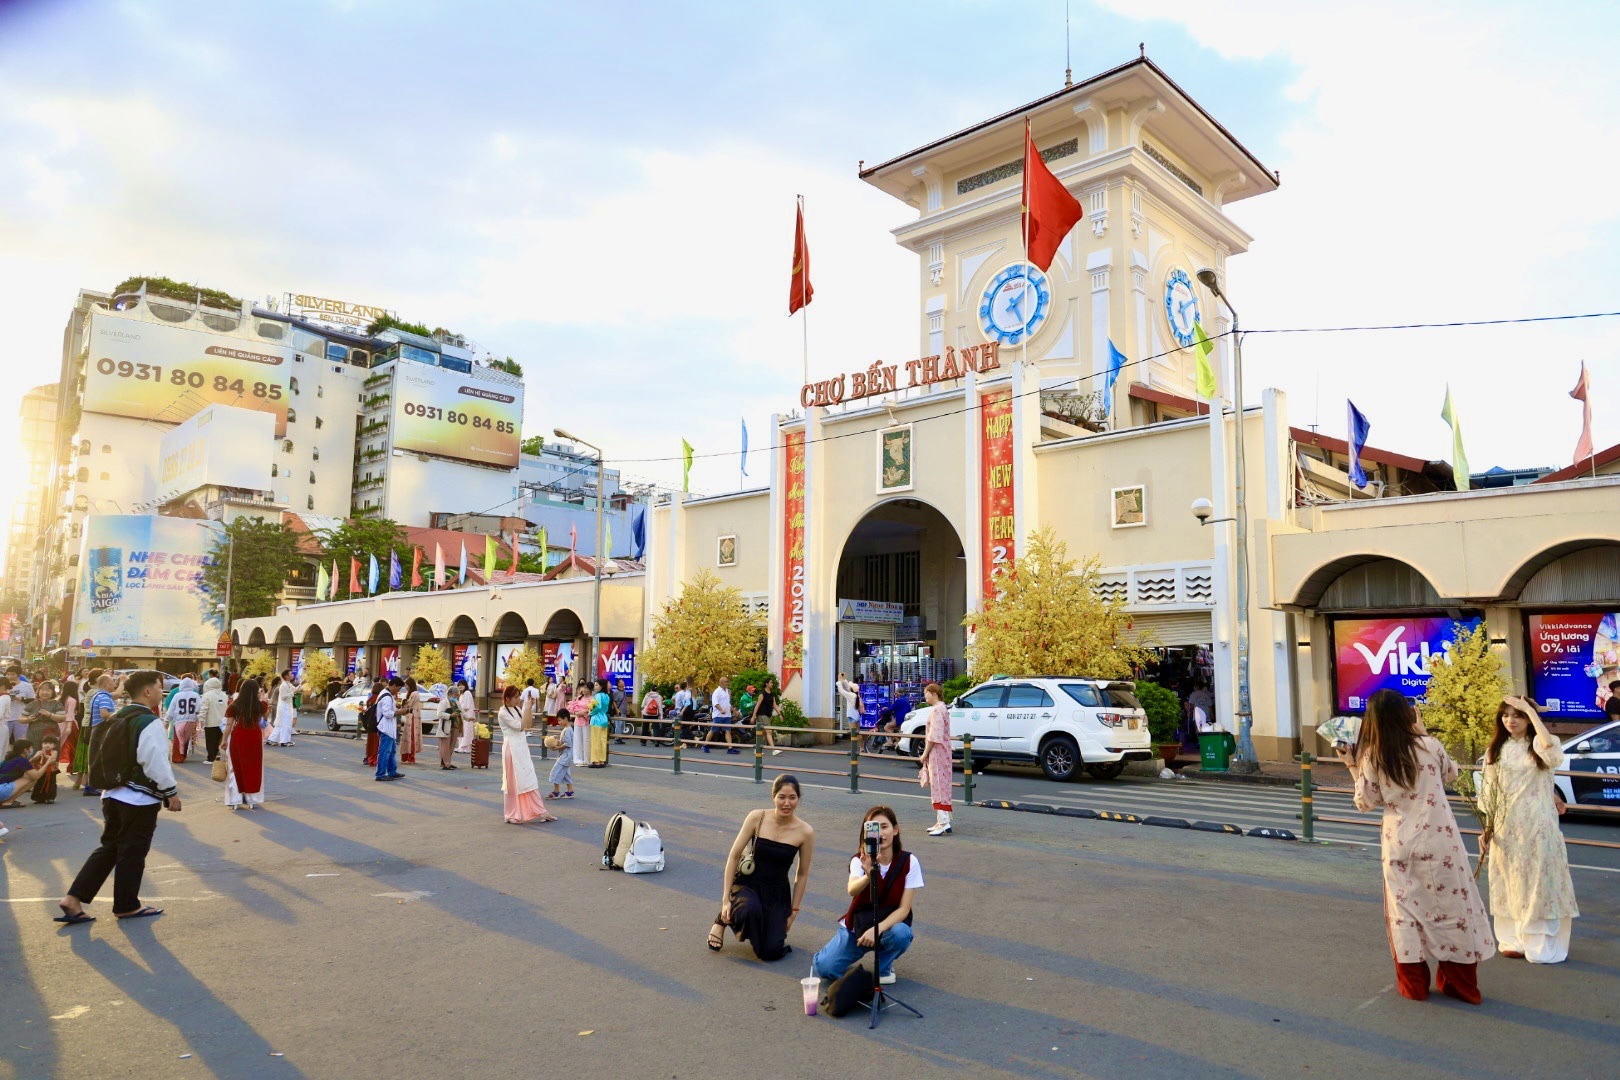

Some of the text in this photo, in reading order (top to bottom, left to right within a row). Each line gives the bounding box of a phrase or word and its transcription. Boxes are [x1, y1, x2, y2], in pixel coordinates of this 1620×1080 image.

[294, 294, 385, 319] SILVERLAND
[96, 357, 282, 400] 0931 80 84 85
[800, 341, 1000, 408] CHỢ BẾN THÀNH
[404, 402, 514, 434] 0931 80 84 85
[989, 463, 1013, 489] NEW
[988, 516, 1015, 541] YEAR
[791, 565, 804, 634] 2025
[1540, 631, 1589, 642] Ứng lương
[1541, 643, 1580, 653] 0% lãi
[602, 645, 632, 673] Vikki
[178, 697, 197, 715] 96
